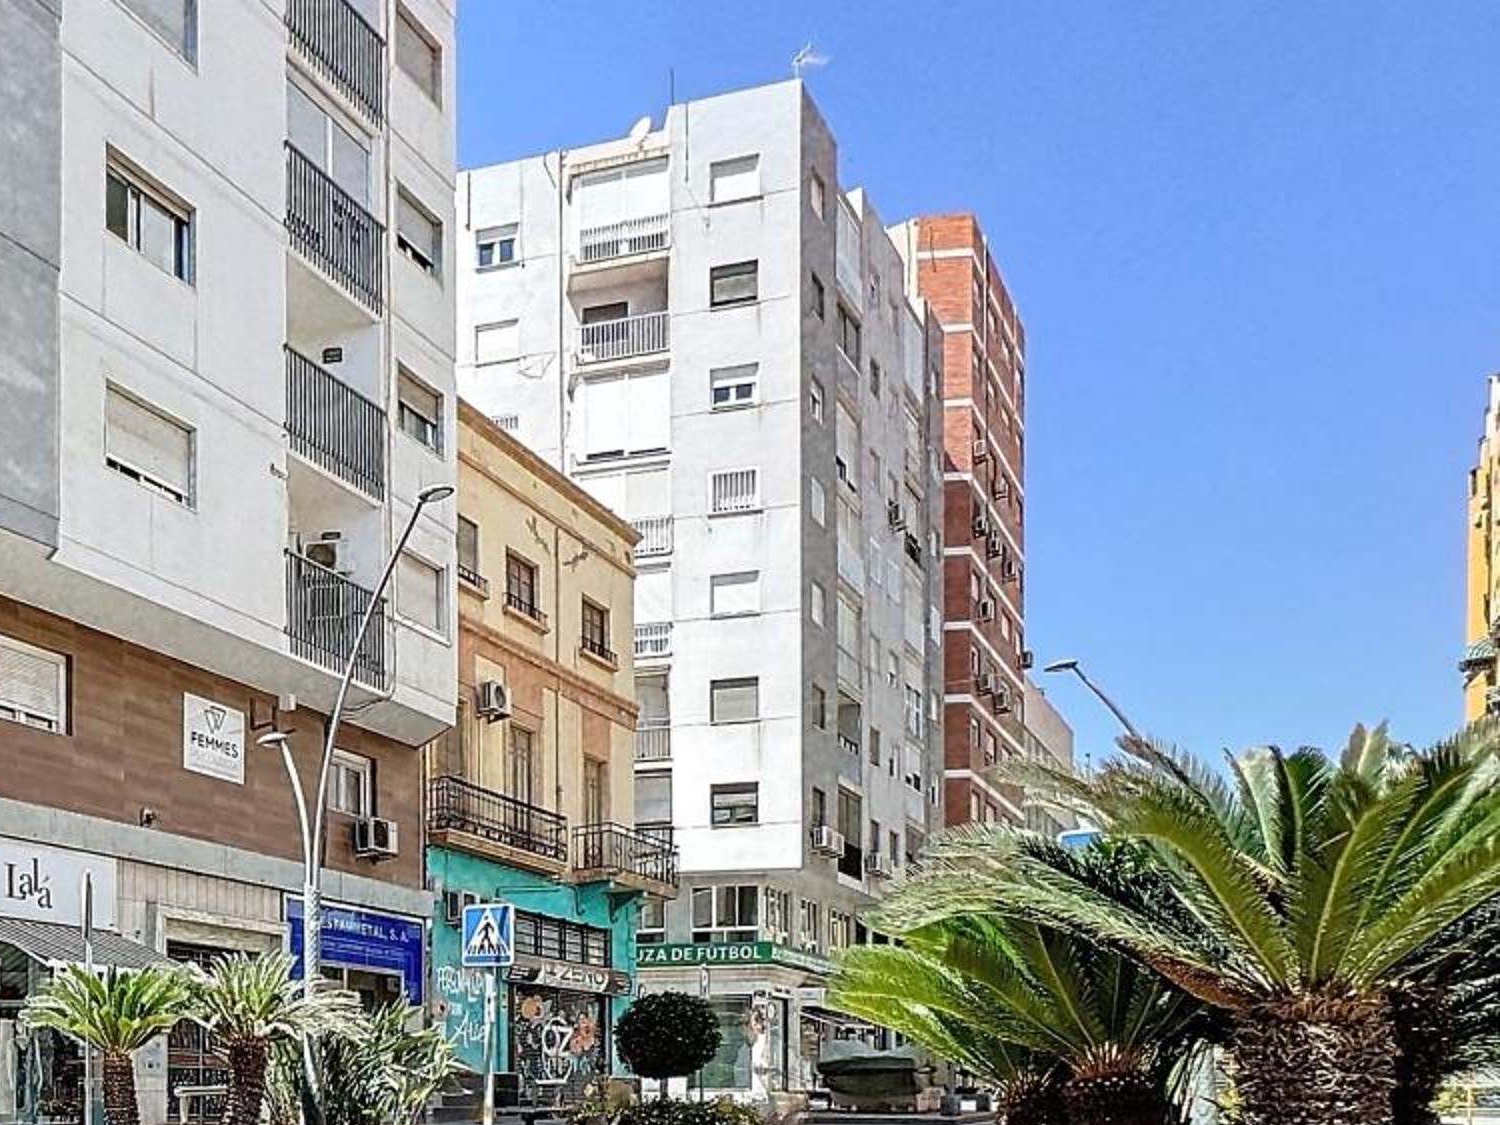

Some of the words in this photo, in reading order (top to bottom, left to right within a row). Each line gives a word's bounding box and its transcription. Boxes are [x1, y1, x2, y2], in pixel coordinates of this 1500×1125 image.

[191, 731, 239, 759] FEMMES
[3, 857, 53, 909] Lalá
[671, 947, 692, 961] DE
